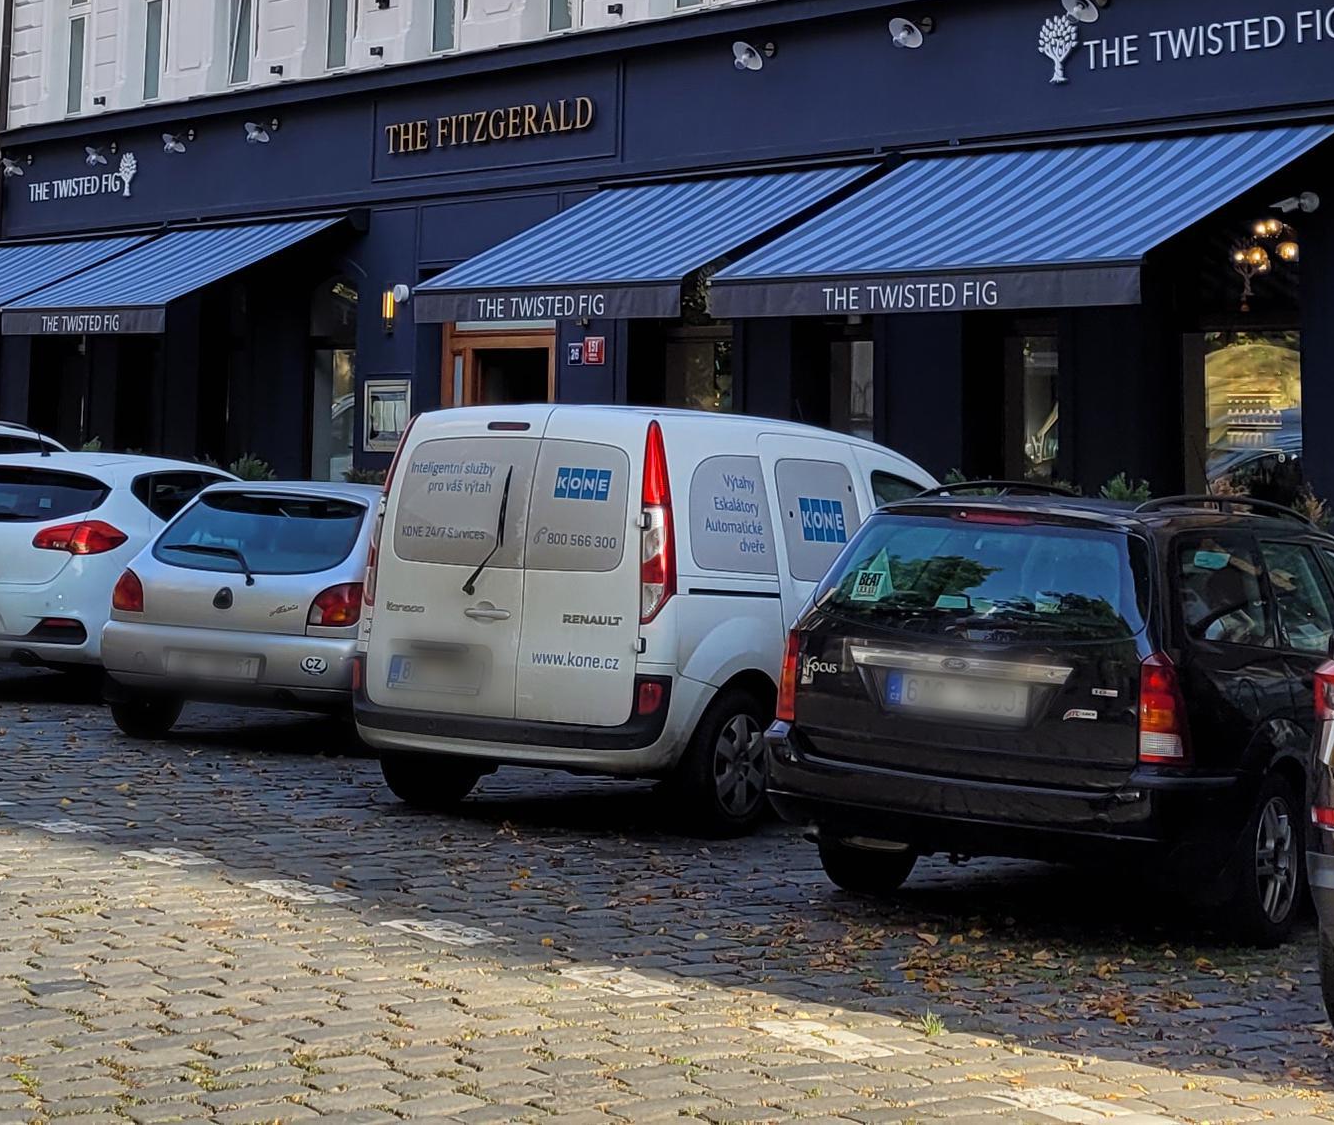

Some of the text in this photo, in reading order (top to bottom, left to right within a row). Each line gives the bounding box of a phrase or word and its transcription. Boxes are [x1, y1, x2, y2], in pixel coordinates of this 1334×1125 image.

[1083, 35, 1139, 69] THE
[1149, 15, 1285, 61] TWISTED
[385, 96, 594, 155] THE FITZGERALD
[28, 172, 121, 202] THE TWISTED FIG
[822, 280, 998, 310] THE TWISTED FIG
[478, 294, 605, 318] THE TWISTED FIG
[42, 314, 120, 332] THE TWISTED FIG
[411, 462, 496, 479] Inteligentní služby
[427, 480, 492, 495] pro váš výtah
[723, 474, 755, 492] Výtahy
[714, 497, 760, 517] Eskalátory
[402, 525, 424, 537] KONE
[705, 518, 764, 536] Automatické
[547, 532, 617, 549] 800 566 300
[739, 538, 766, 553] dveře
[858, 572, 884, 587] BEAT
[562, 614, 623, 626] RENAULT
[305, 657, 322, 670] CZ
[531, 652, 620, 671] www.kone.cz
